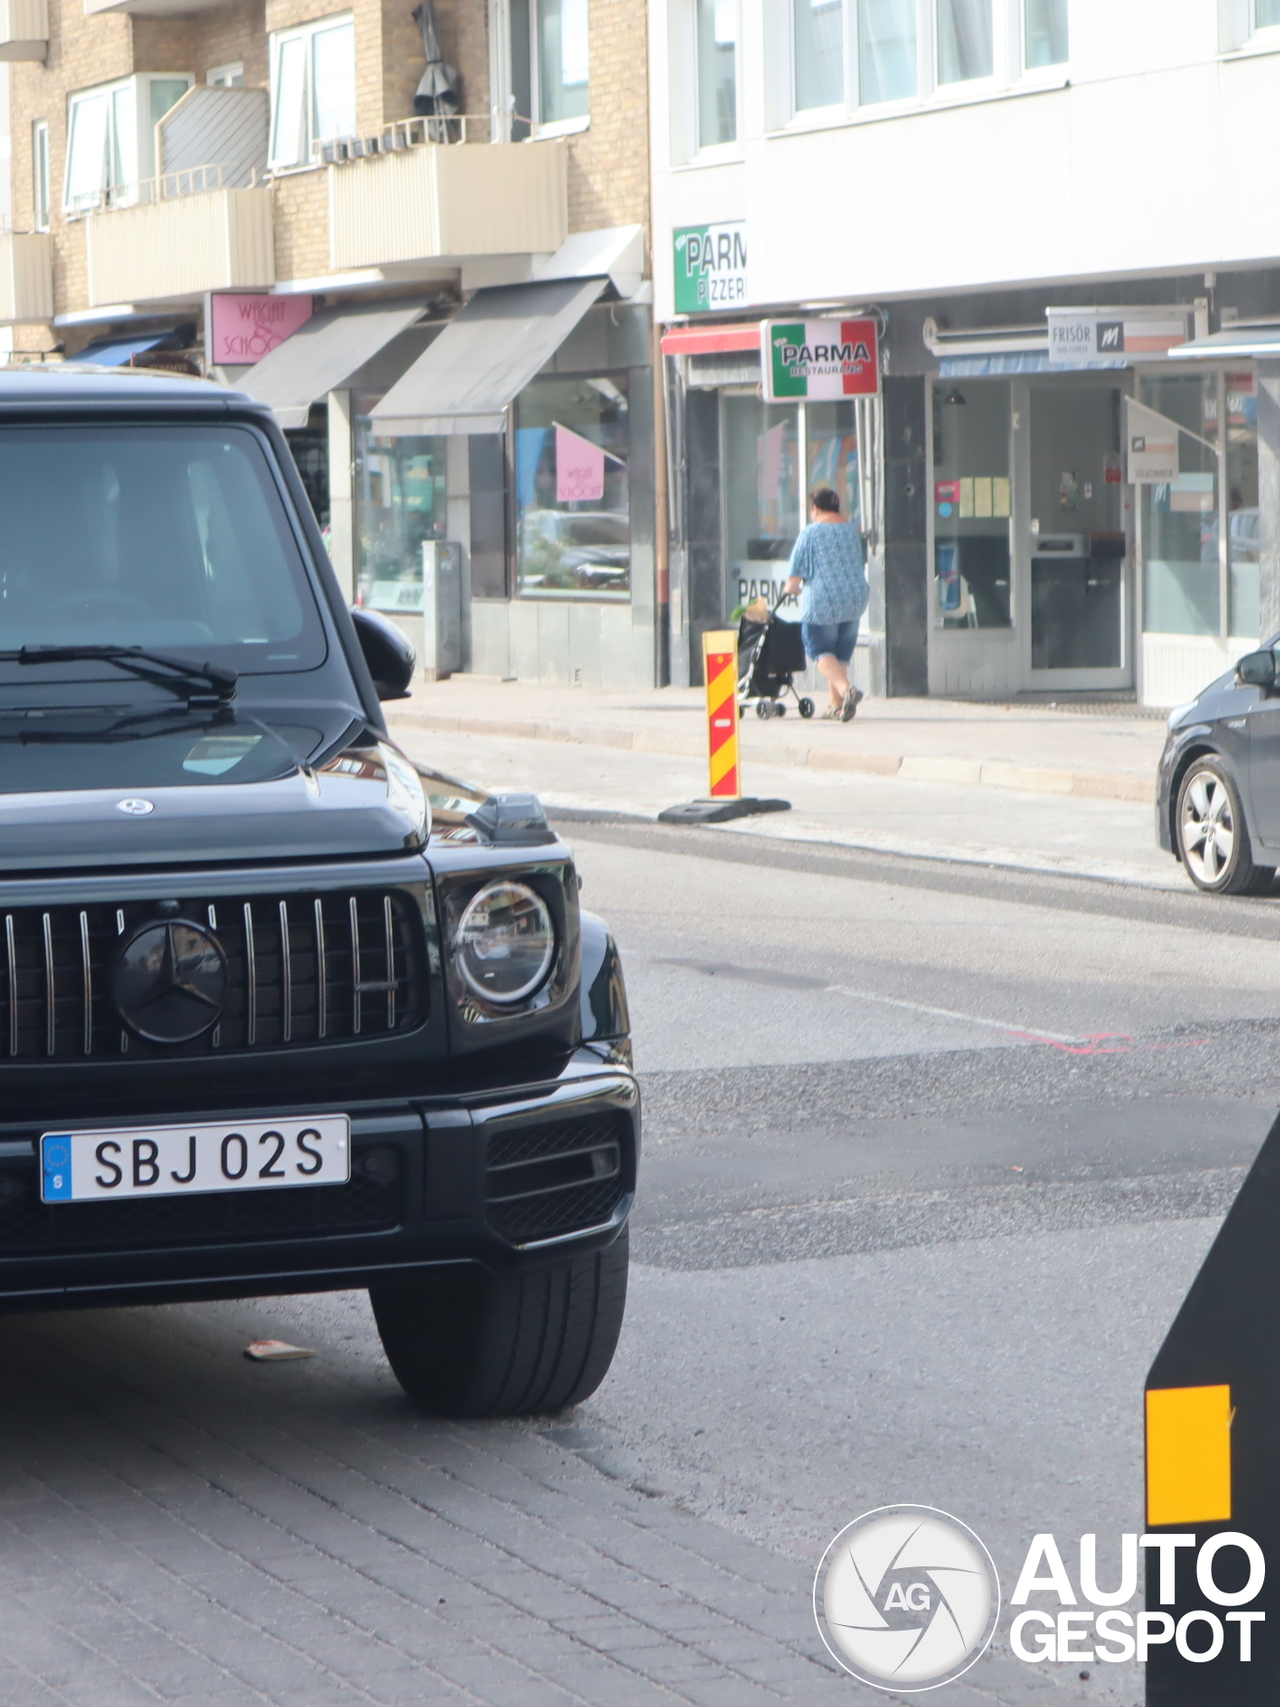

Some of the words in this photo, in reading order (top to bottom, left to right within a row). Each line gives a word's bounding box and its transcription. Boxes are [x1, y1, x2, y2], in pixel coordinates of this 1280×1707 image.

[698, 277, 748, 301] PIZZER
[1053, 323, 1091, 342] FRISÖR
[783, 342, 870, 364] PARMA
[790, 363, 864, 378] RESTAURANG
[95, 1135, 197, 1188] SBJ
[220, 1128, 323, 1180] 02S
[53, 1175, 63, 1188] S
